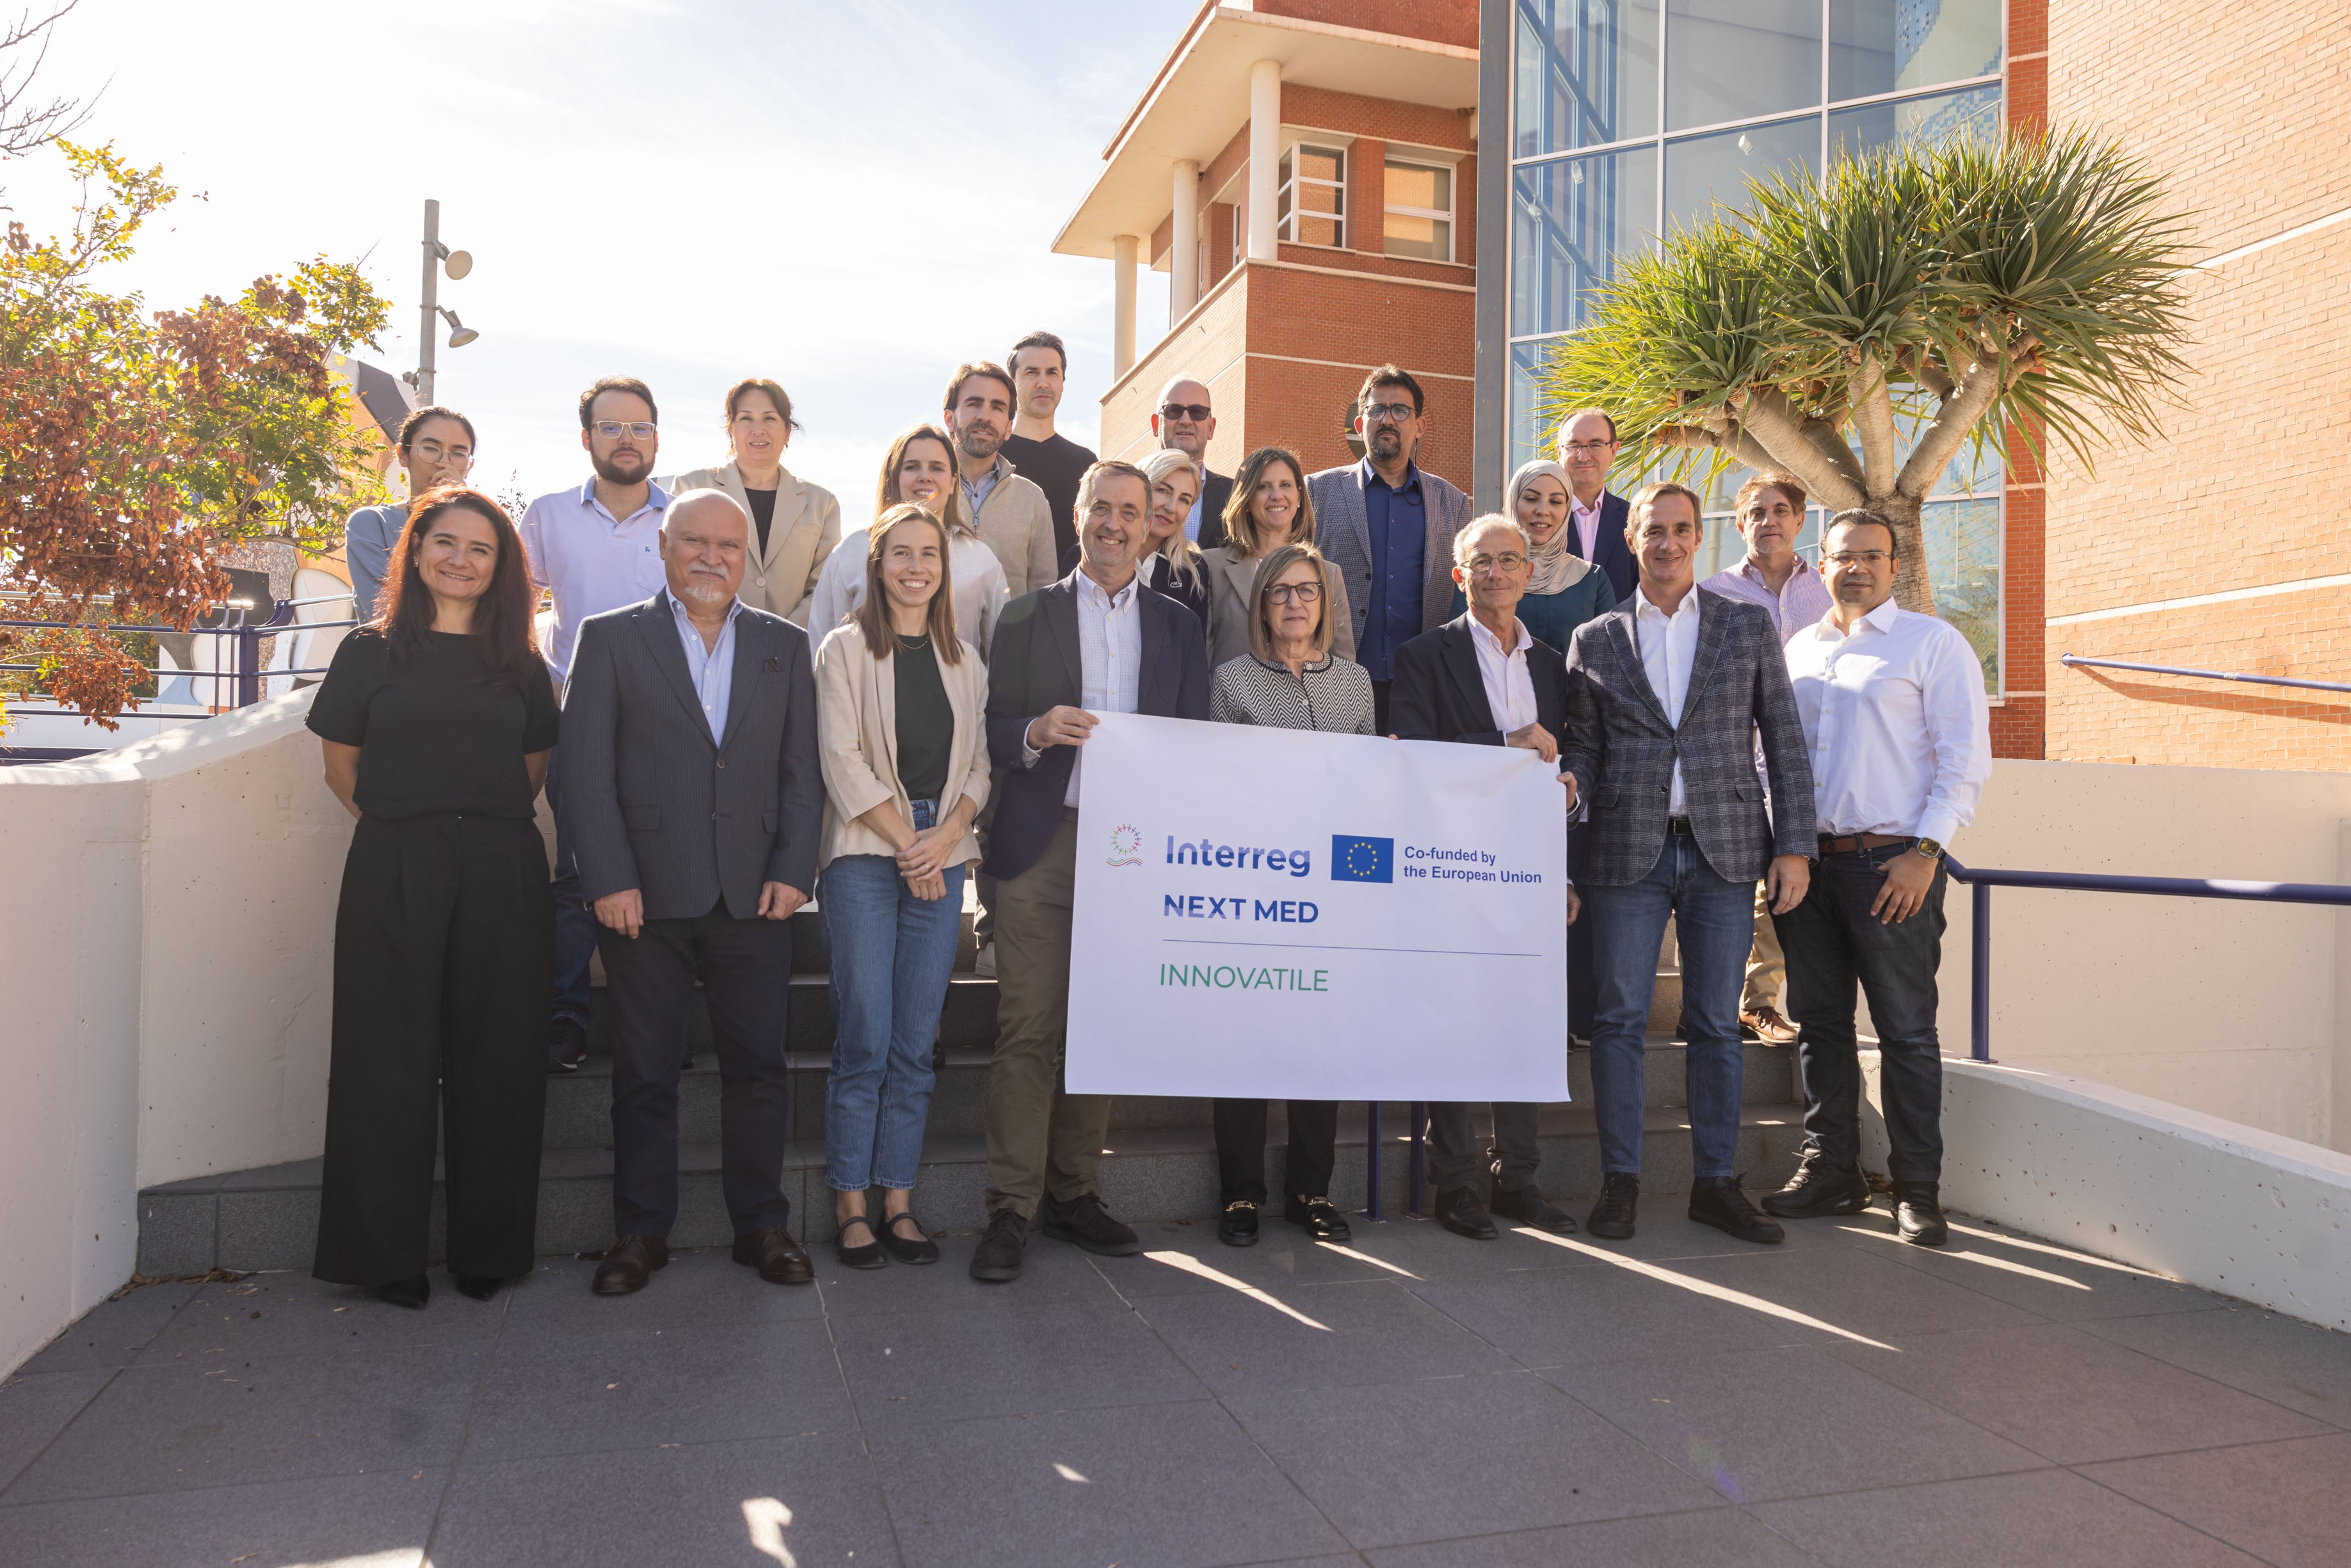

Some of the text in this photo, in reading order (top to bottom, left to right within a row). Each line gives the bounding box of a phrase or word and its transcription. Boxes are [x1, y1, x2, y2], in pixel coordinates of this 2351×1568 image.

[1166, 835, 1311, 877] Interreg
[1404, 845, 1496, 867] Co-funded by
[1403, 865, 1542, 883] the European Union
[1163, 894, 1319, 924] NEXT MED
[1160, 963, 1329, 992] INNOVATILE
